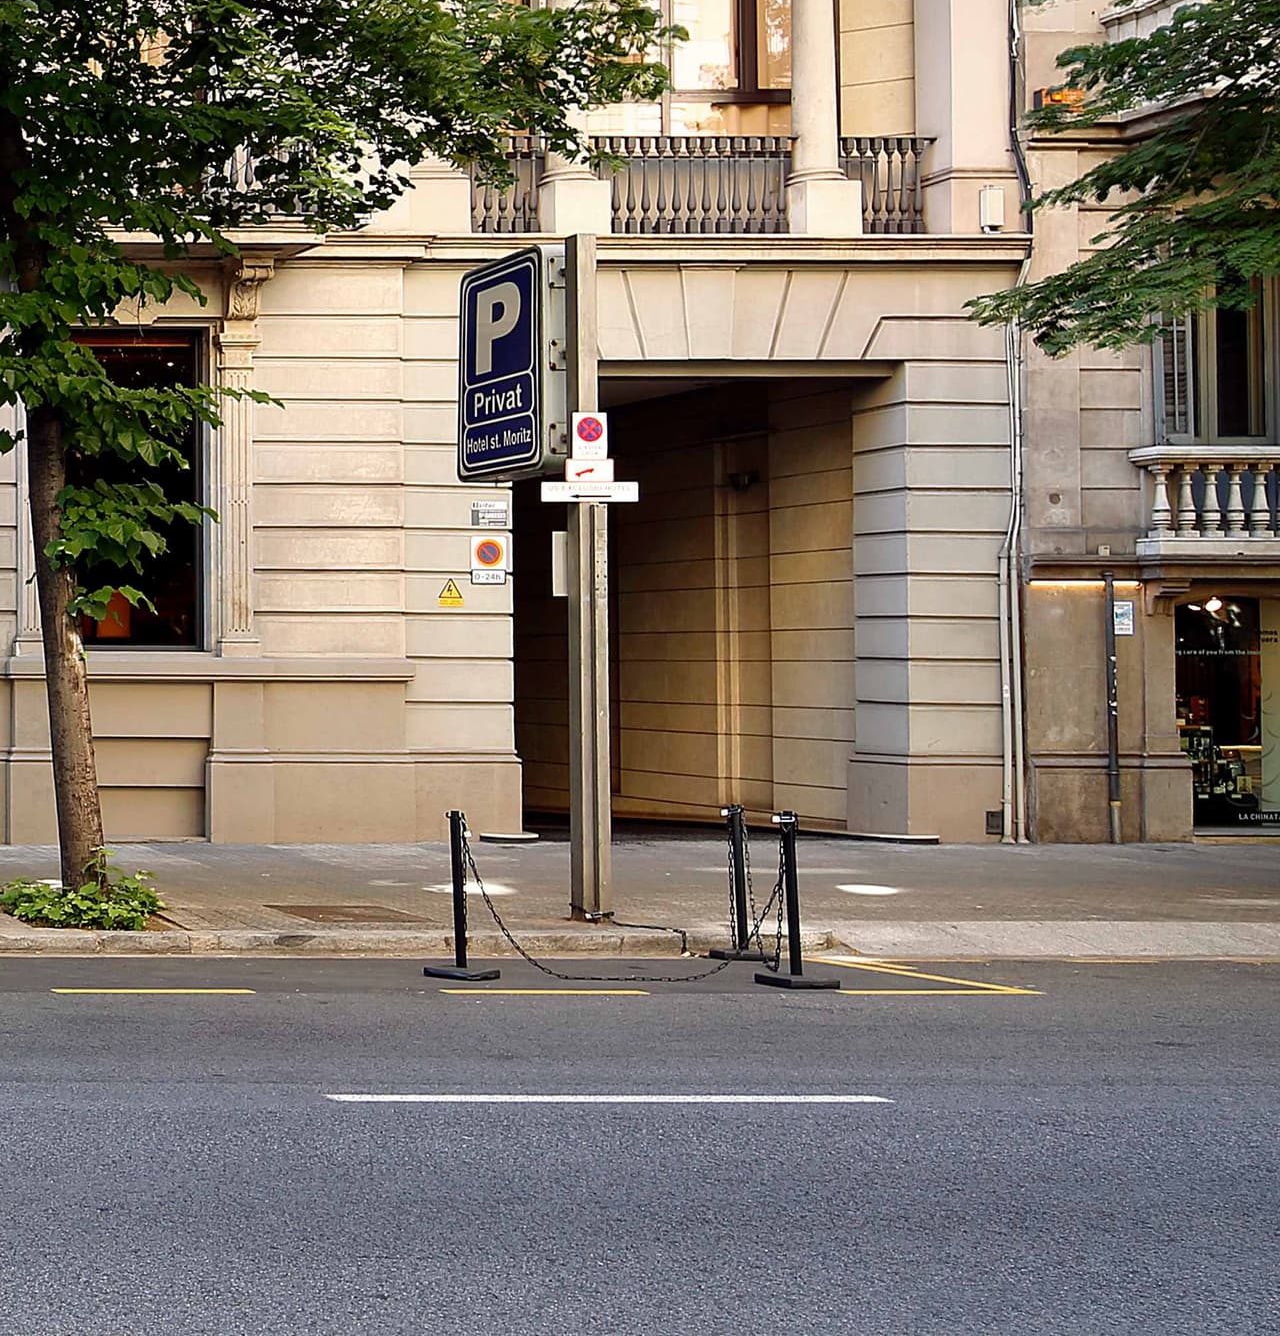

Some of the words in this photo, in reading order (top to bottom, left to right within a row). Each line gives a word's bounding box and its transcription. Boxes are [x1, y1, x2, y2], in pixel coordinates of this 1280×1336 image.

[475, 281, 521, 376] P
[473, 382, 523, 418] Privat
[466, 434, 489, 455] Hotel
[490, 433, 502, 449] st.
[503, 428, 532, 447] Moritz
